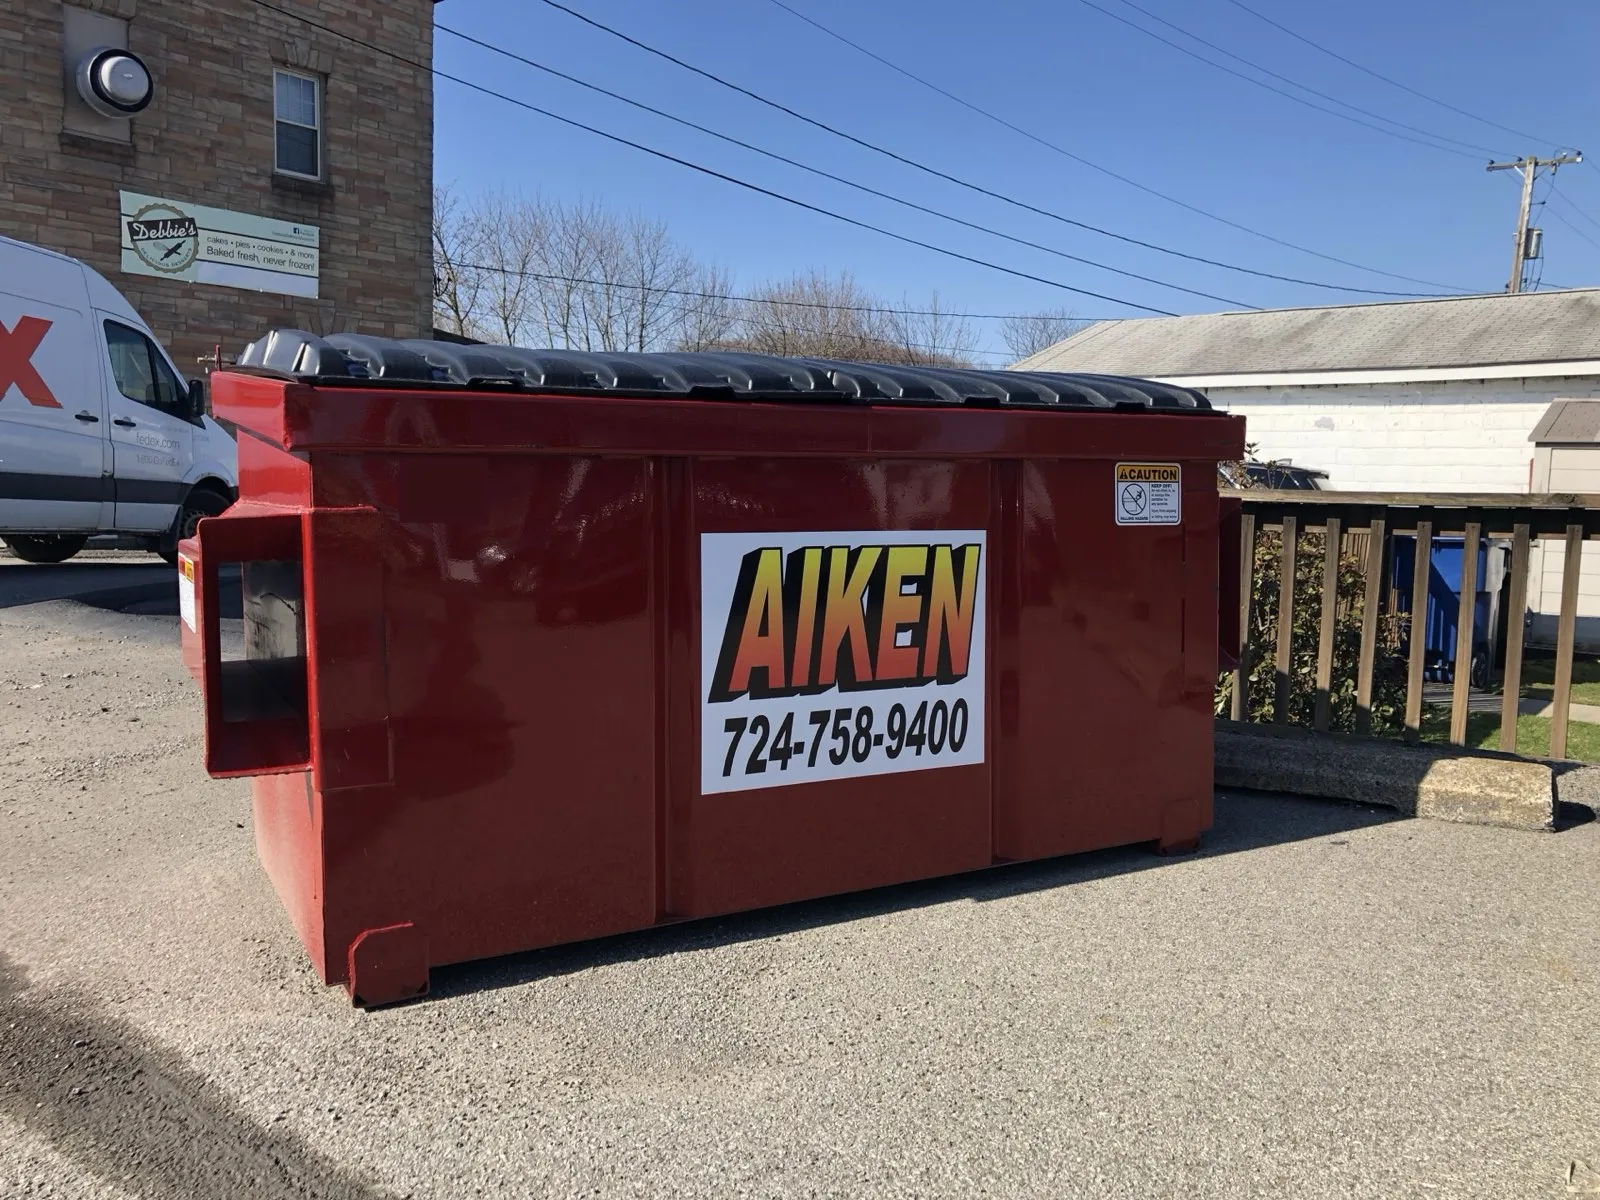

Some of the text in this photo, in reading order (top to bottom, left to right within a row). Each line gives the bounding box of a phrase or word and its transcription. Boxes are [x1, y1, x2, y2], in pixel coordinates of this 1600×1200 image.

[132, 220, 197, 240] Debbie's
[206, 245, 315, 271] Baked fresh, never frozen!
[207, 236, 229, 246] cakes
[235, 240, 250, 249] pies
[257, 244, 284, 255] cookies
[298, 251, 315, 260] more
[136, 431, 180, 449] fedex.com
[1128, 468, 1177, 481] CAUTION
[707, 543, 982, 704] AIKEN
[722, 698, 969, 778] 724-758-9400
